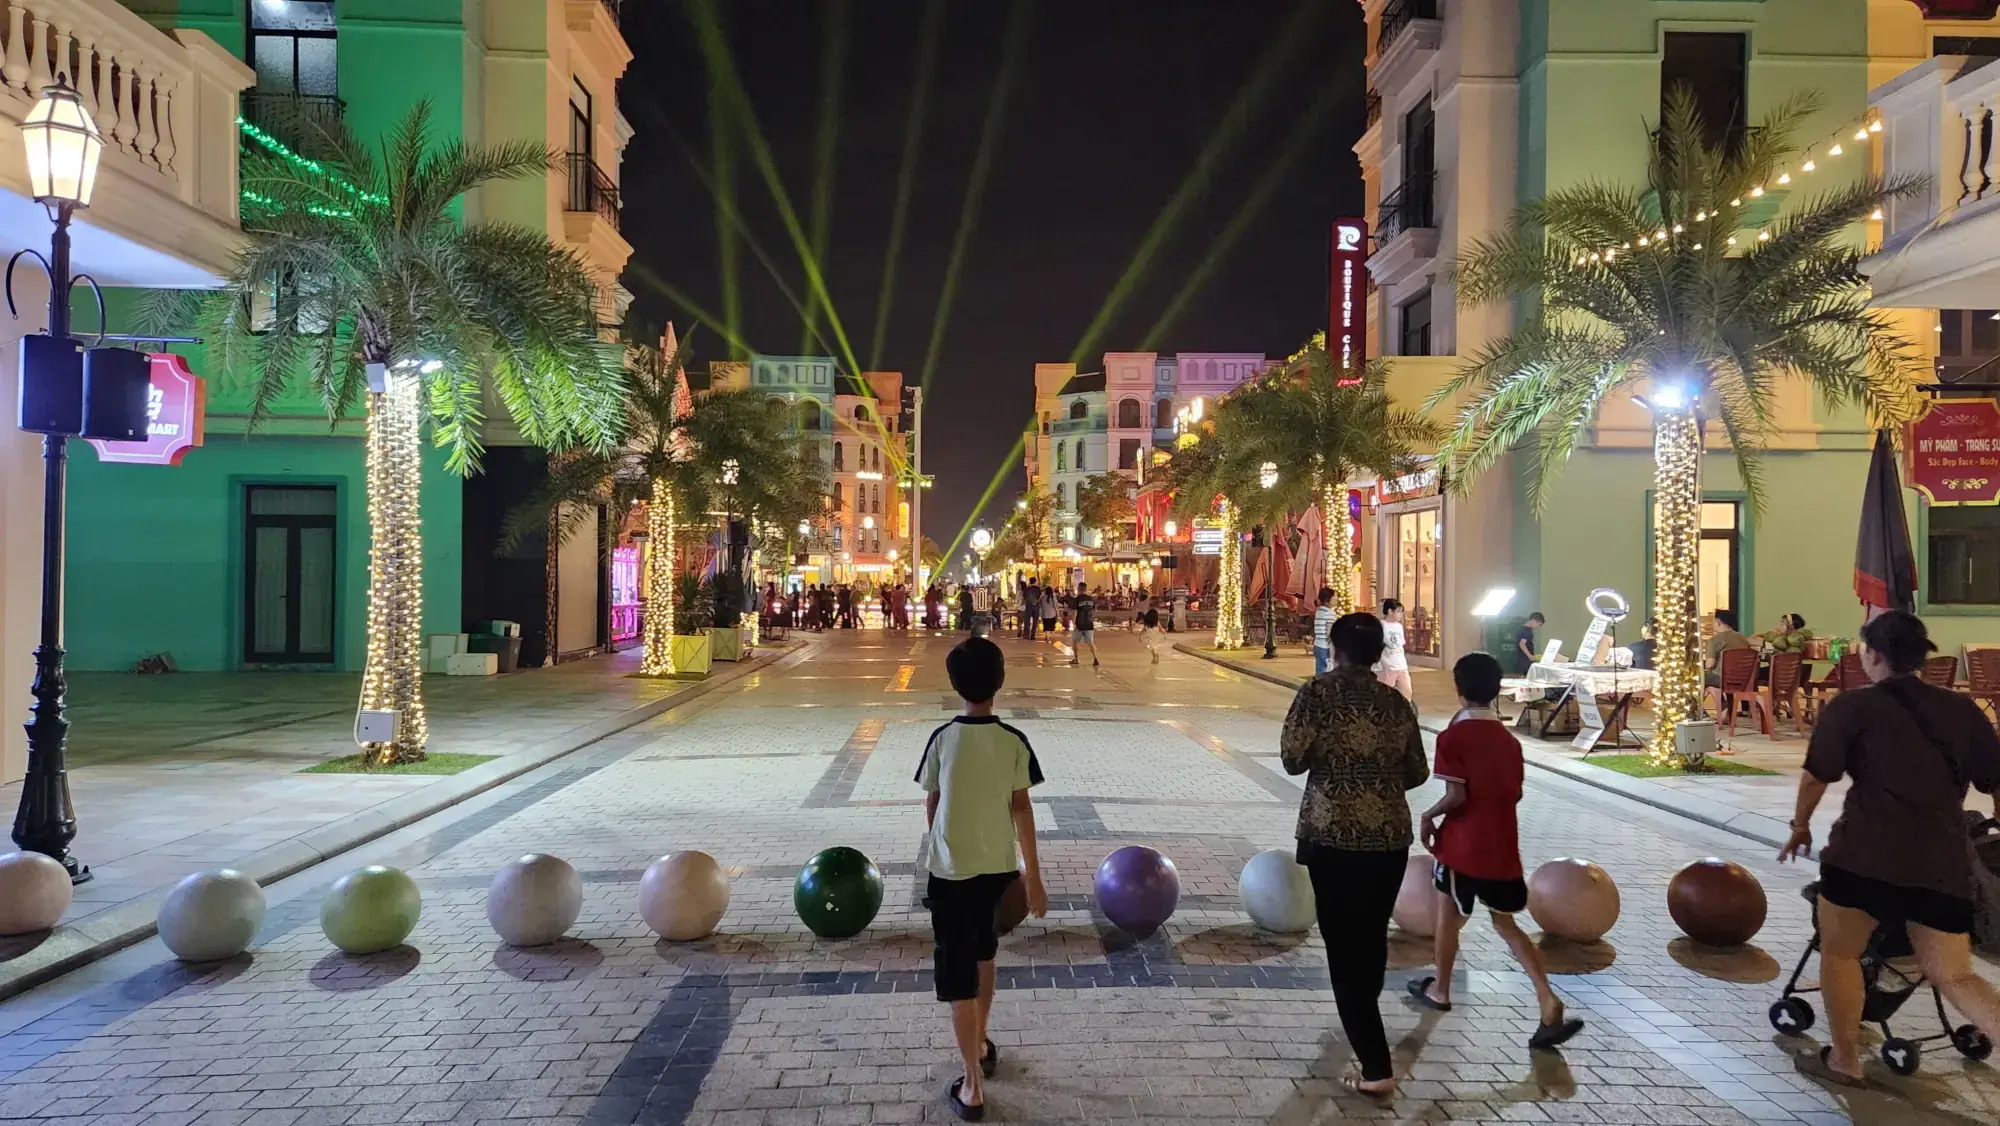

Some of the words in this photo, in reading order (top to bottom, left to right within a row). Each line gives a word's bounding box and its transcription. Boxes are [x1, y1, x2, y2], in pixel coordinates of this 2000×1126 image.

[1343, 259, 1352, 327] BOUTIQUE
[1342, 334, 1351, 369] CAFE
[1965, 438, 1990, 452] TRANG
[1980, 456, 1999, 467] Body
